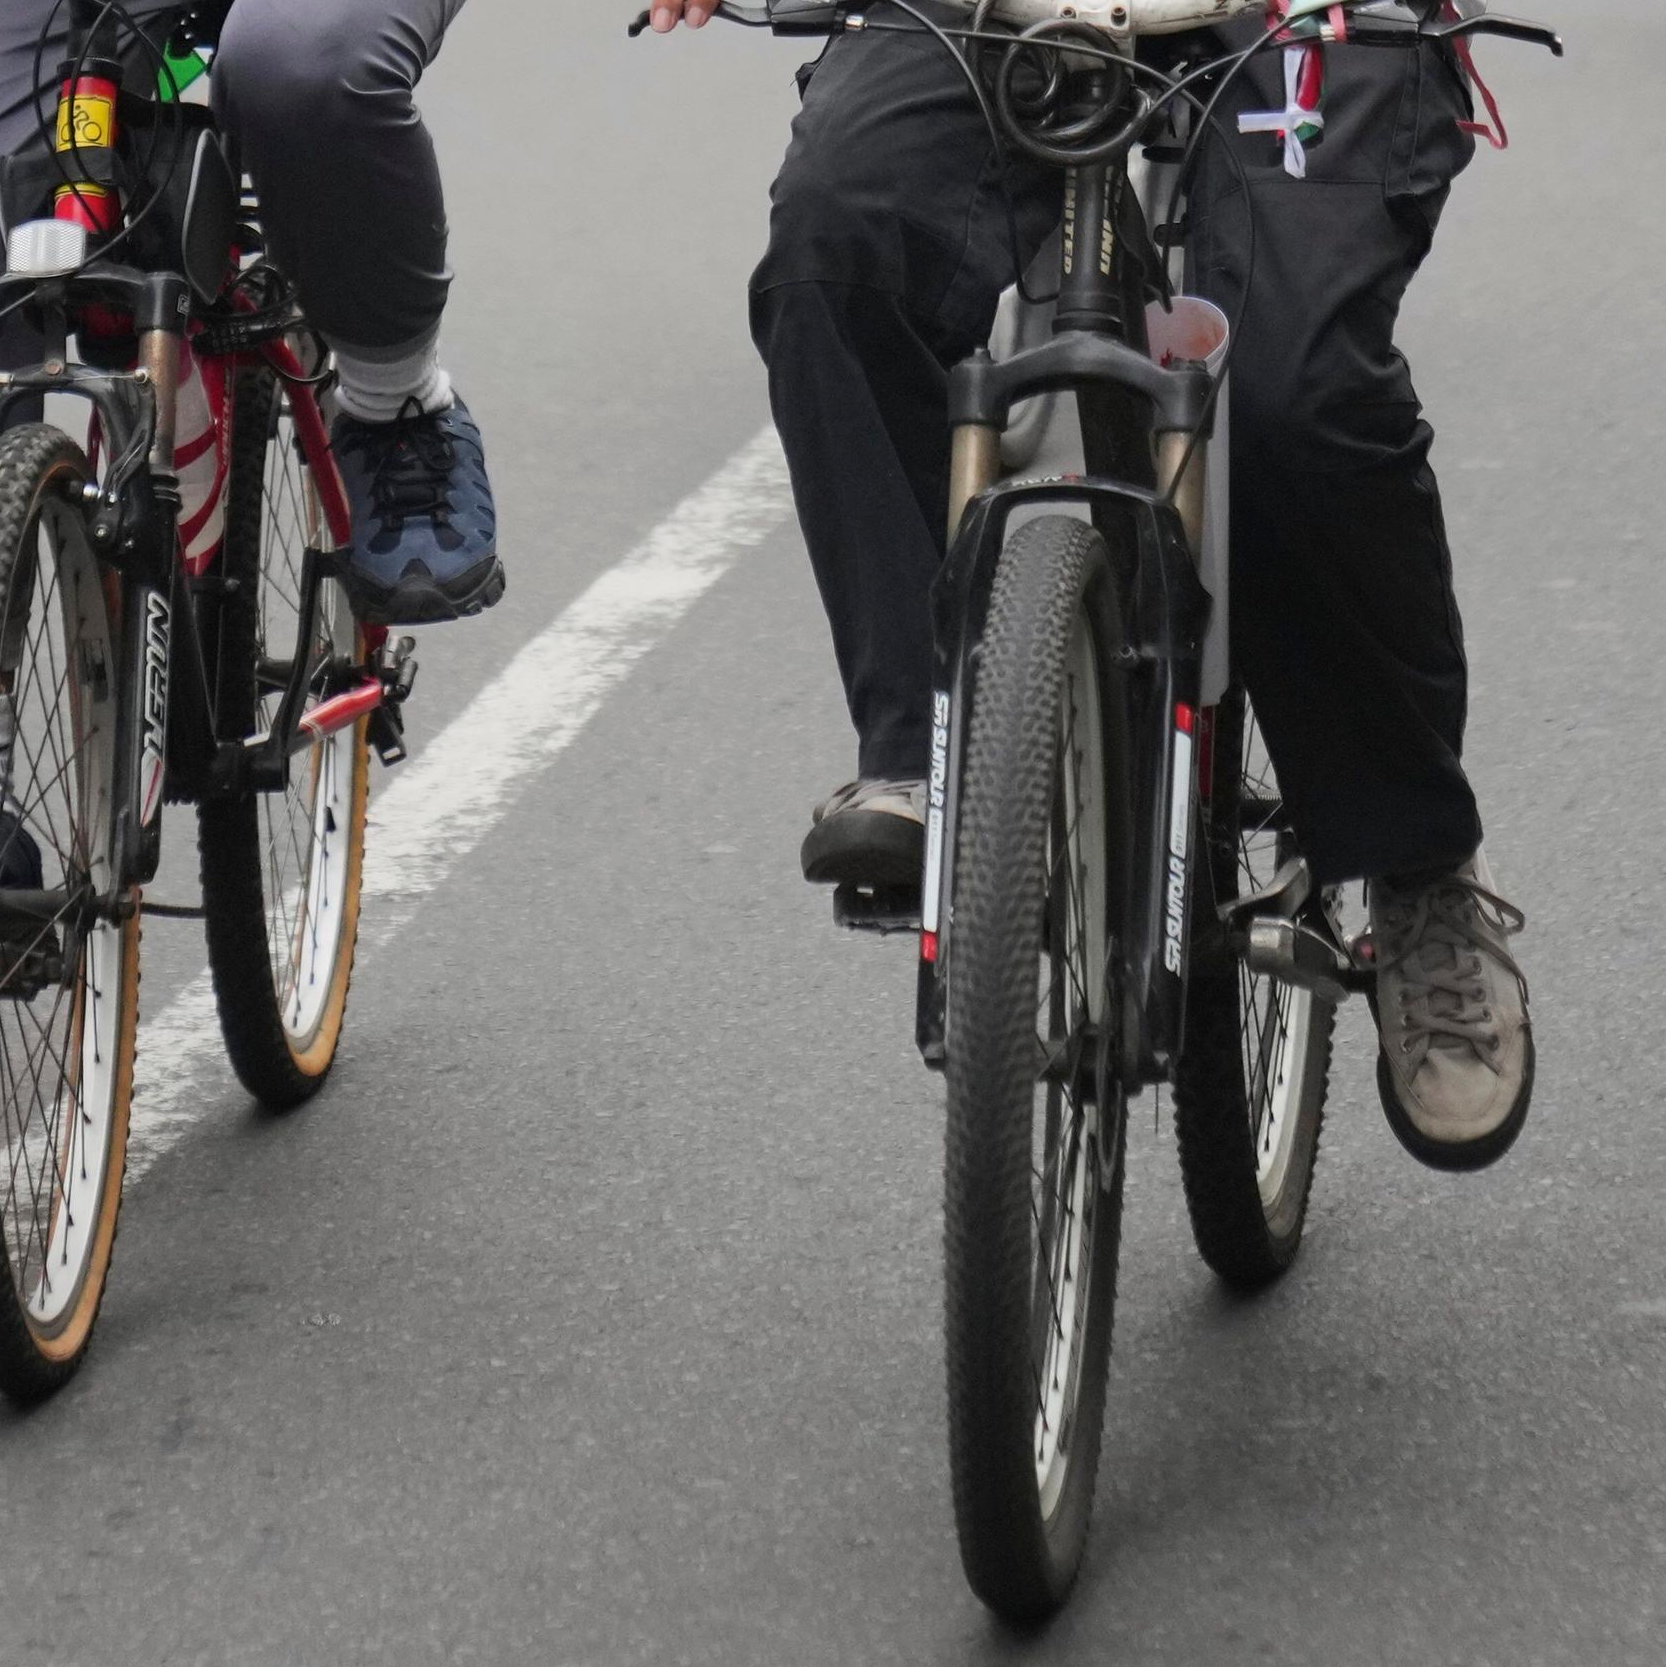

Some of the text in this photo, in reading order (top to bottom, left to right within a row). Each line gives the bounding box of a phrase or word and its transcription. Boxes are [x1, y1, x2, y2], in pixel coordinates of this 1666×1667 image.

[144, 591, 171, 751] LERUN
[929, 726, 948, 808] SUNTOUR
[1166, 856, 1186, 940] SUNTOUR
